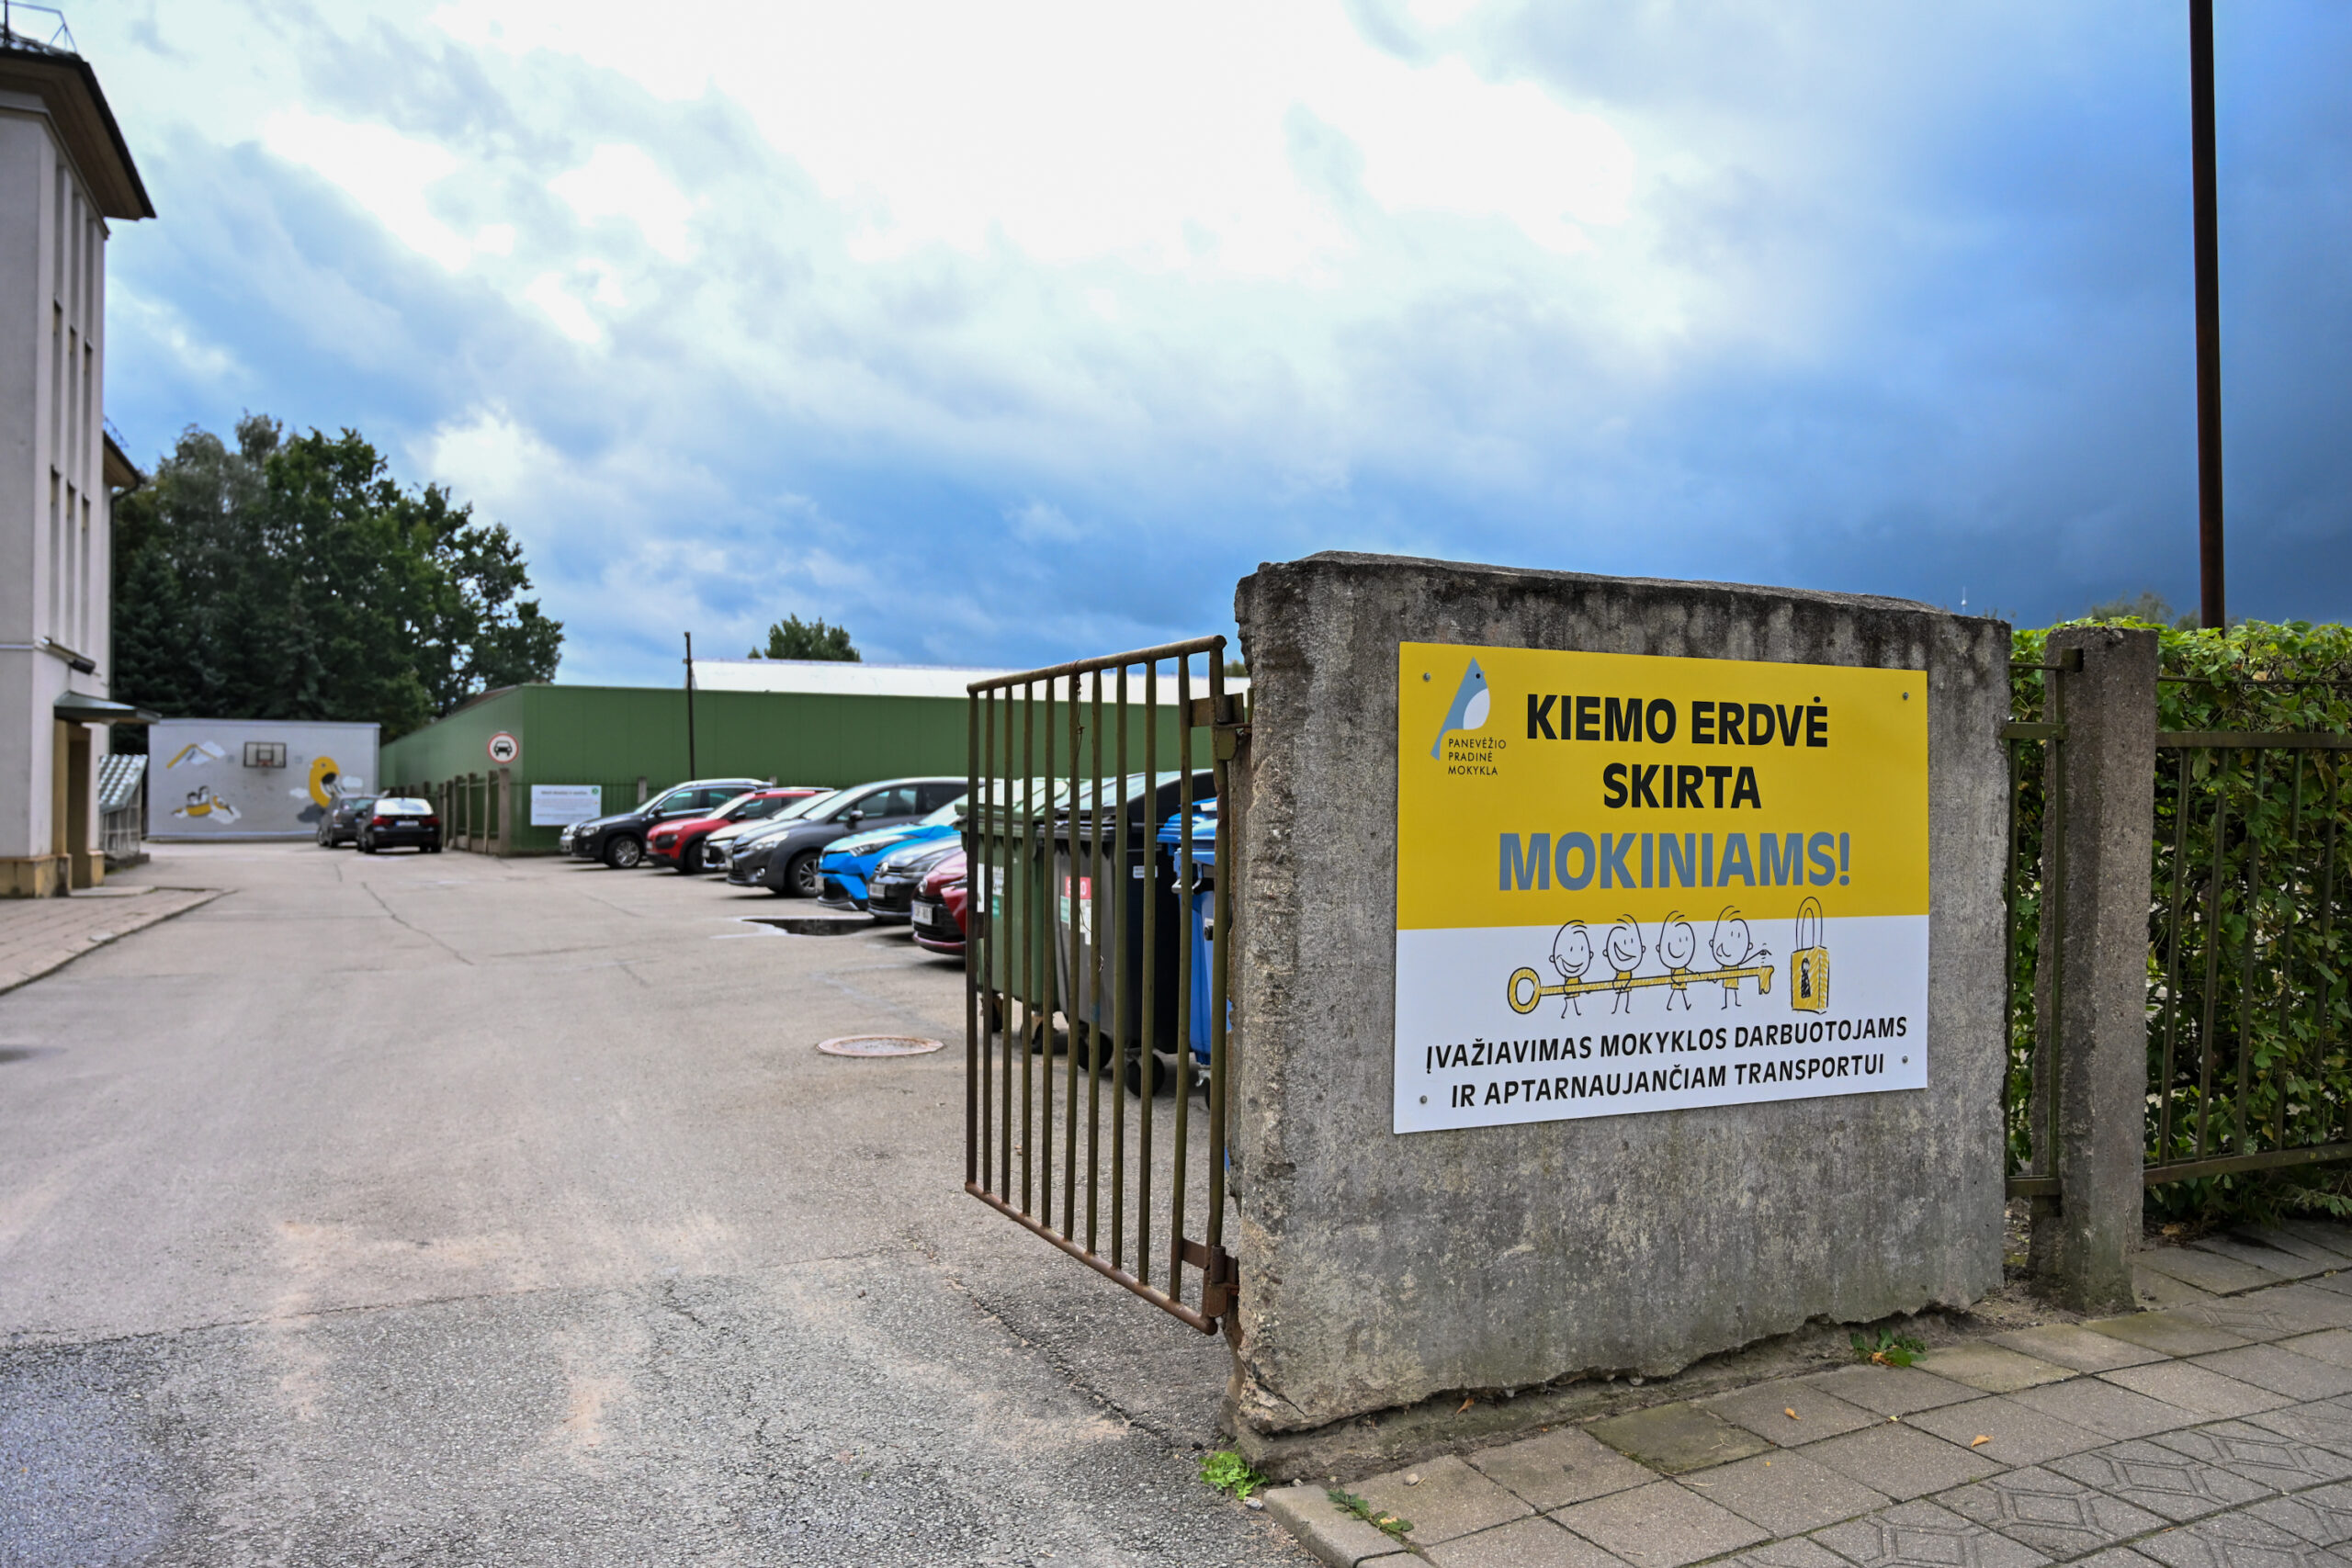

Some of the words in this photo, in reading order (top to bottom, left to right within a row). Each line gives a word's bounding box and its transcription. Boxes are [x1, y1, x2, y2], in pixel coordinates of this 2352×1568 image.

[1448, 737, 1507, 750] PANEVĖŽIO
[1527, 694, 1677, 744] KIEMO
[1691, 695, 1828, 748] ERDVĖ
[1448, 750, 1493, 762] PRADINĖ
[1448, 765, 1498, 776] MOKYKLA
[1602, 762, 1762, 809] SKIRTA
[1498, 830, 1850, 891] MOKINIAMS!
[1426, 1035, 1592, 1075] ĮVAŽIAVIMAS
[1600, 1027, 1727, 1058] MOKYKLOS
[1735, 1016, 1907, 1048] DARBUOTOJAMS
[1452, 1084, 1476, 1109] IR
[1484, 1064, 1726, 1105] APTARNAUJANČIAM
[1734, 1053, 1884, 1086] TRANSPORTUI
